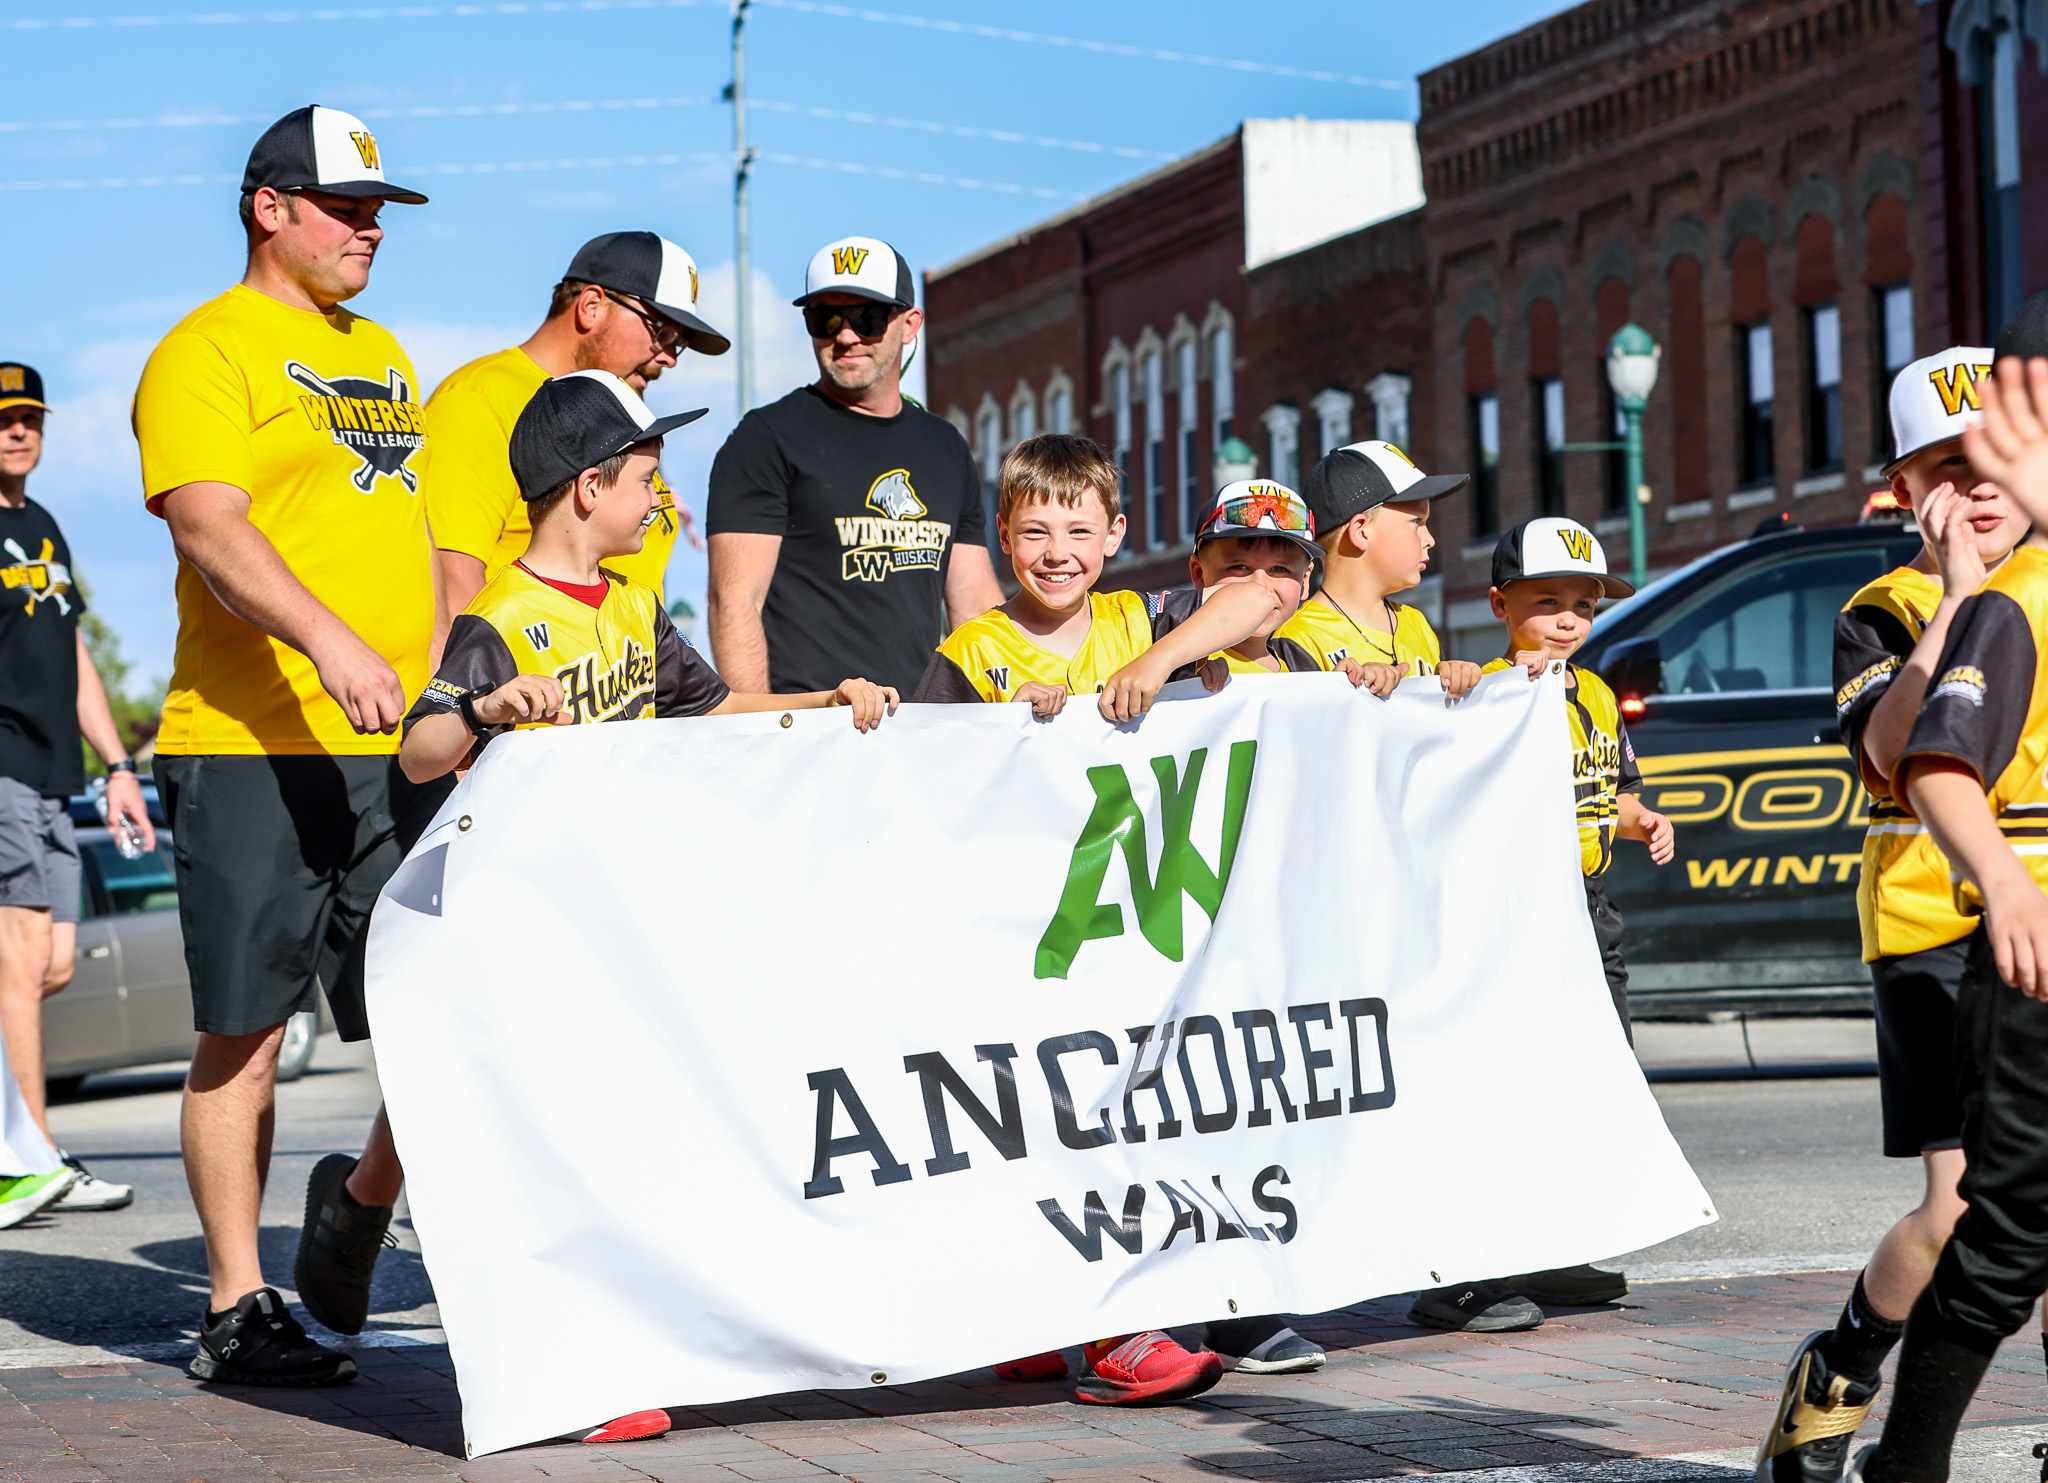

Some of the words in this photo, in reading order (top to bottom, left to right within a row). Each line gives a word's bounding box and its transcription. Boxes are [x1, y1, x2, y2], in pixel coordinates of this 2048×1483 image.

[349, 131, 379, 170] W
[832, 246, 869, 275] W
[0, 366, 25, 391] W
[1929, 363, 1993, 416] W
[331, 428, 376, 447] LITTLE
[377, 432, 426, 450] LEAGUE
[834, 516, 951, 552] WINTERSET
[1556, 529, 1592, 563] W
[853, 550, 890, 582] W
[894, 548, 938, 566] HUSKIES
[523, 621, 551, 652] W
[985, 665, 1010, 691] W
[803, 996, 1397, 1200] ANCHORED
[1035, 1164, 1299, 1263] WALLS
